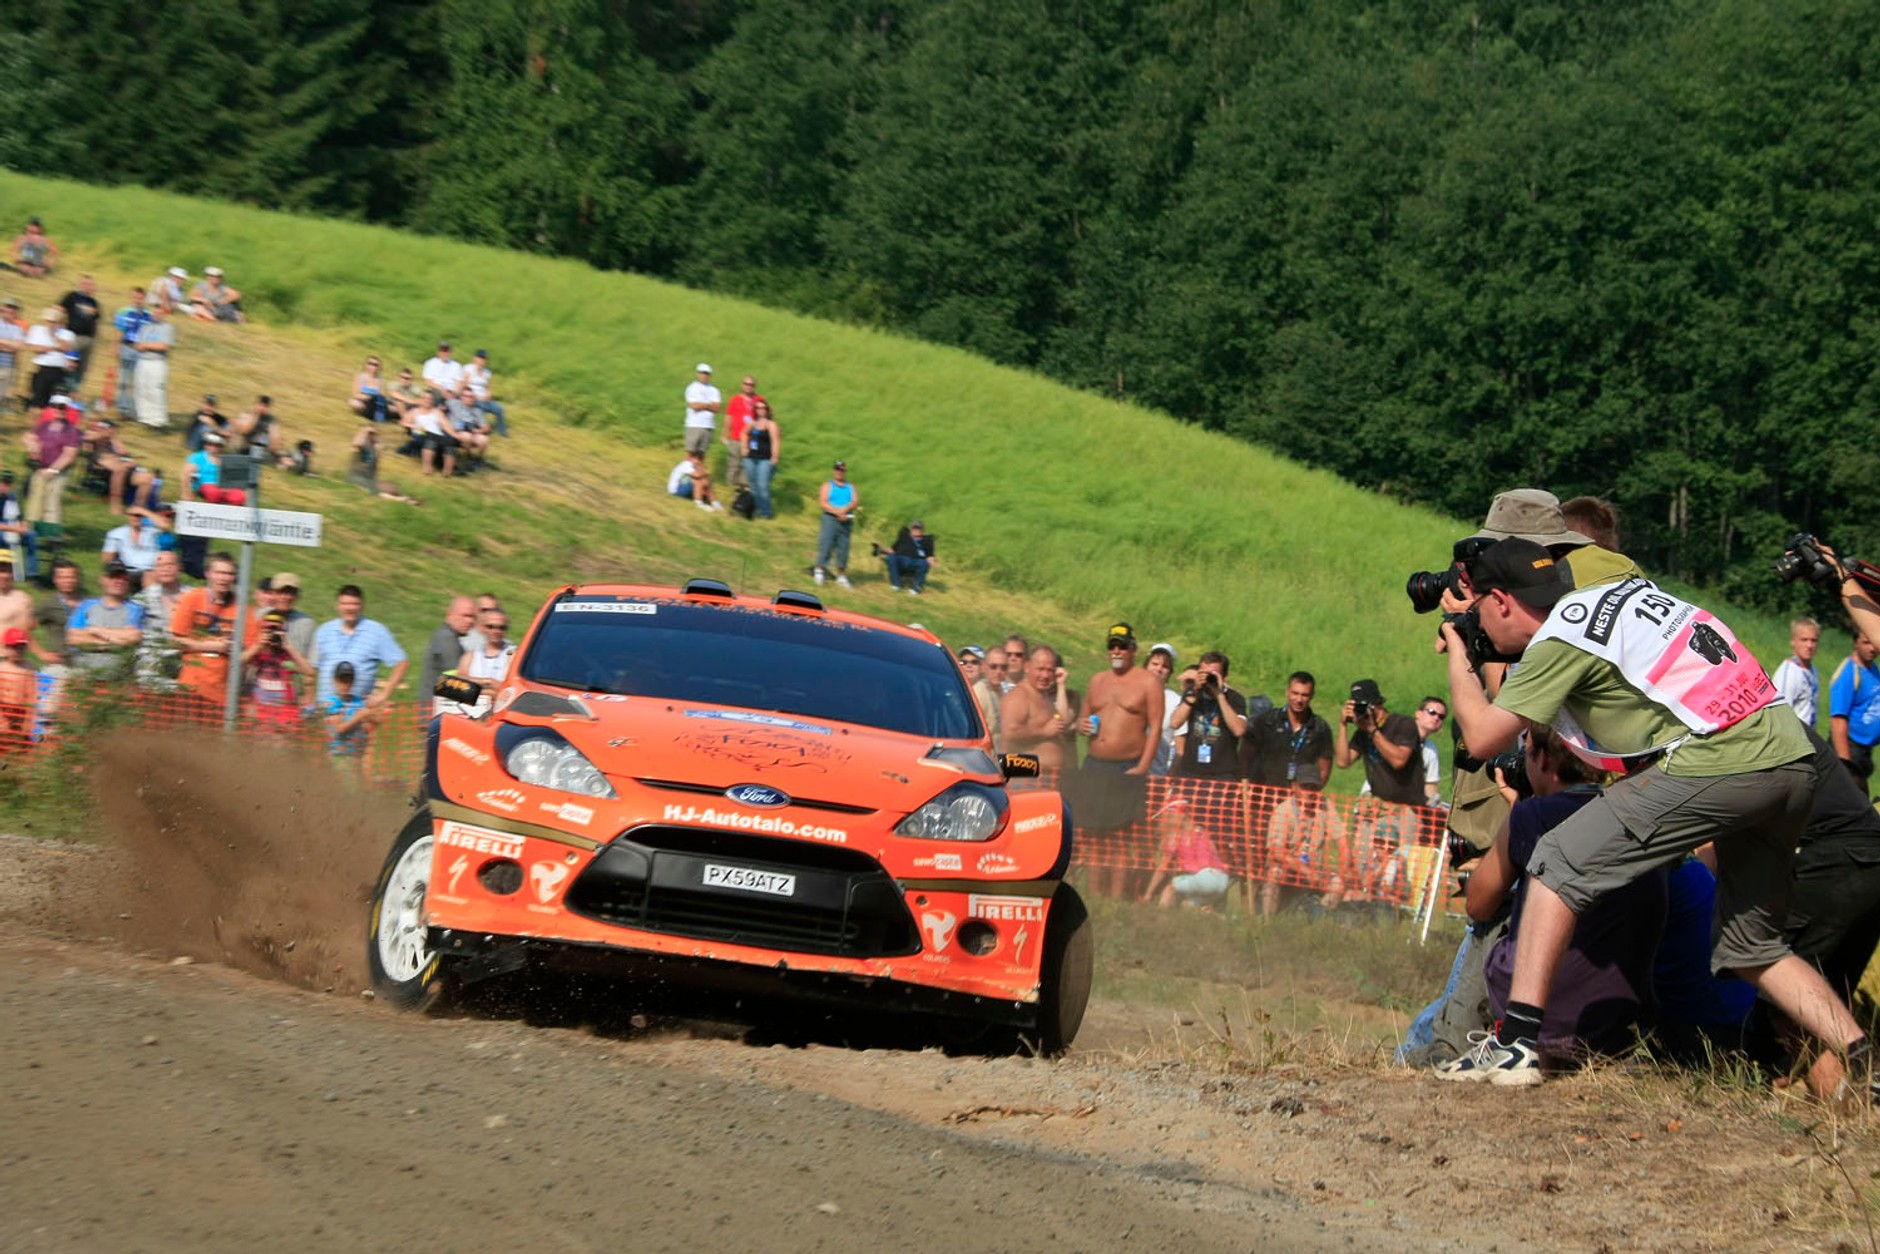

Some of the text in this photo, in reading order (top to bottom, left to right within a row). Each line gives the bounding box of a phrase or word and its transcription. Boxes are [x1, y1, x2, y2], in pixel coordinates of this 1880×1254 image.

[1592, 602, 1616, 637] NESTE
[1634, 593, 1676, 627] 150
[1704, 700, 1721, 716] 29
[1717, 688, 1759, 722] 2010
[739, 786, 776, 804] Ford
[438, 820, 526, 859] PIRELLI
[663, 804, 848, 844] HJ-Autotalo.com
[708, 866, 792, 894] PX59ATZ
[968, 893, 1044, 922] PIRELLI
